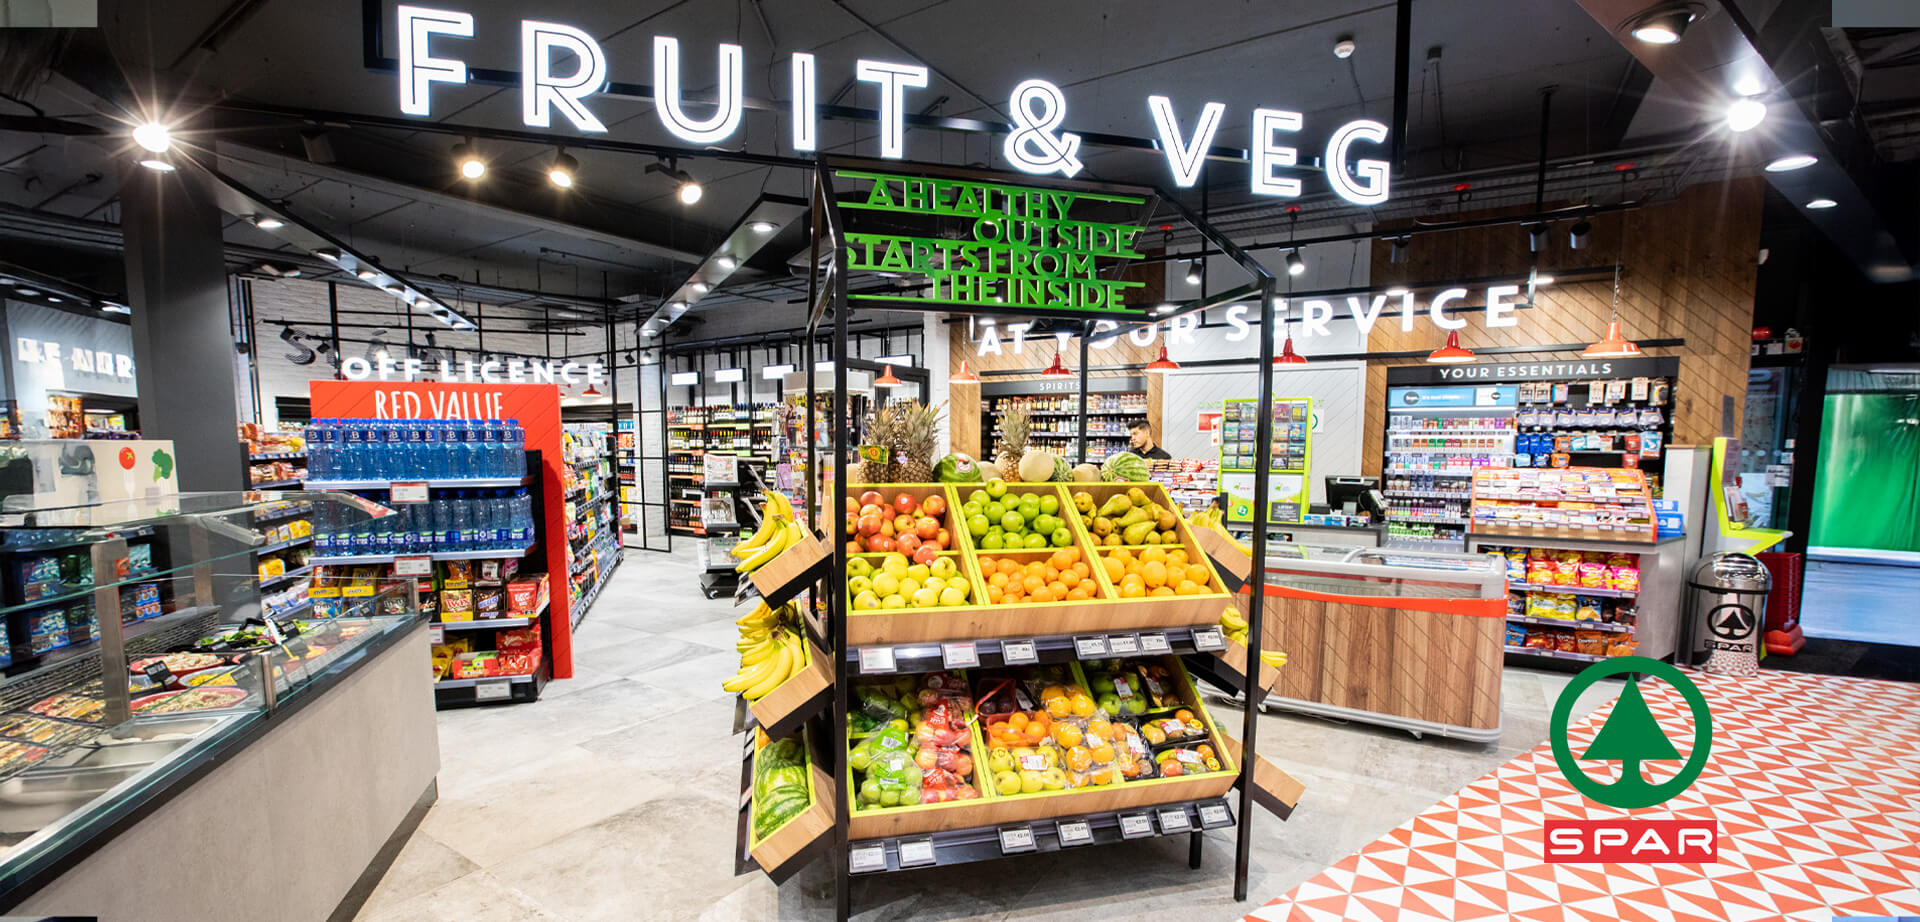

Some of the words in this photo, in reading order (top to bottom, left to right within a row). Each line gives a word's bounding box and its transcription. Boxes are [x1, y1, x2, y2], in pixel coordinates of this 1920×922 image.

[398, 4, 928, 159] FRUIT
[1003, 78, 1082, 178] &
[1148, 95, 1391, 206] VEG
[866, 177, 895, 208] A
[903, 178, 1077, 221] HEALTHY
[973, 216, 1138, 254] OUTSIDE
[988, 243, 1097, 280] FROM
[926, 271, 999, 302] THE
[1007, 276, 1126, 309] INSIDE
[977, 322, 1030, 357] AT
[1054, 313, 1200, 351] YOUR
[1225, 285, 1520, 342] SERVICE
[341, 356, 424, 382] OFF
[440, 359, 605, 385] LICENCE
[1039, 381, 1081, 391] SPIRITS
[1440, 368, 1490, 379] YOUR
[1496, 363, 1612, 377] ESSENTIALS
[374, 389, 422, 420] RED
[427, 390, 504, 424] VALUE
[1704, 639, 1752, 653] SPAR
